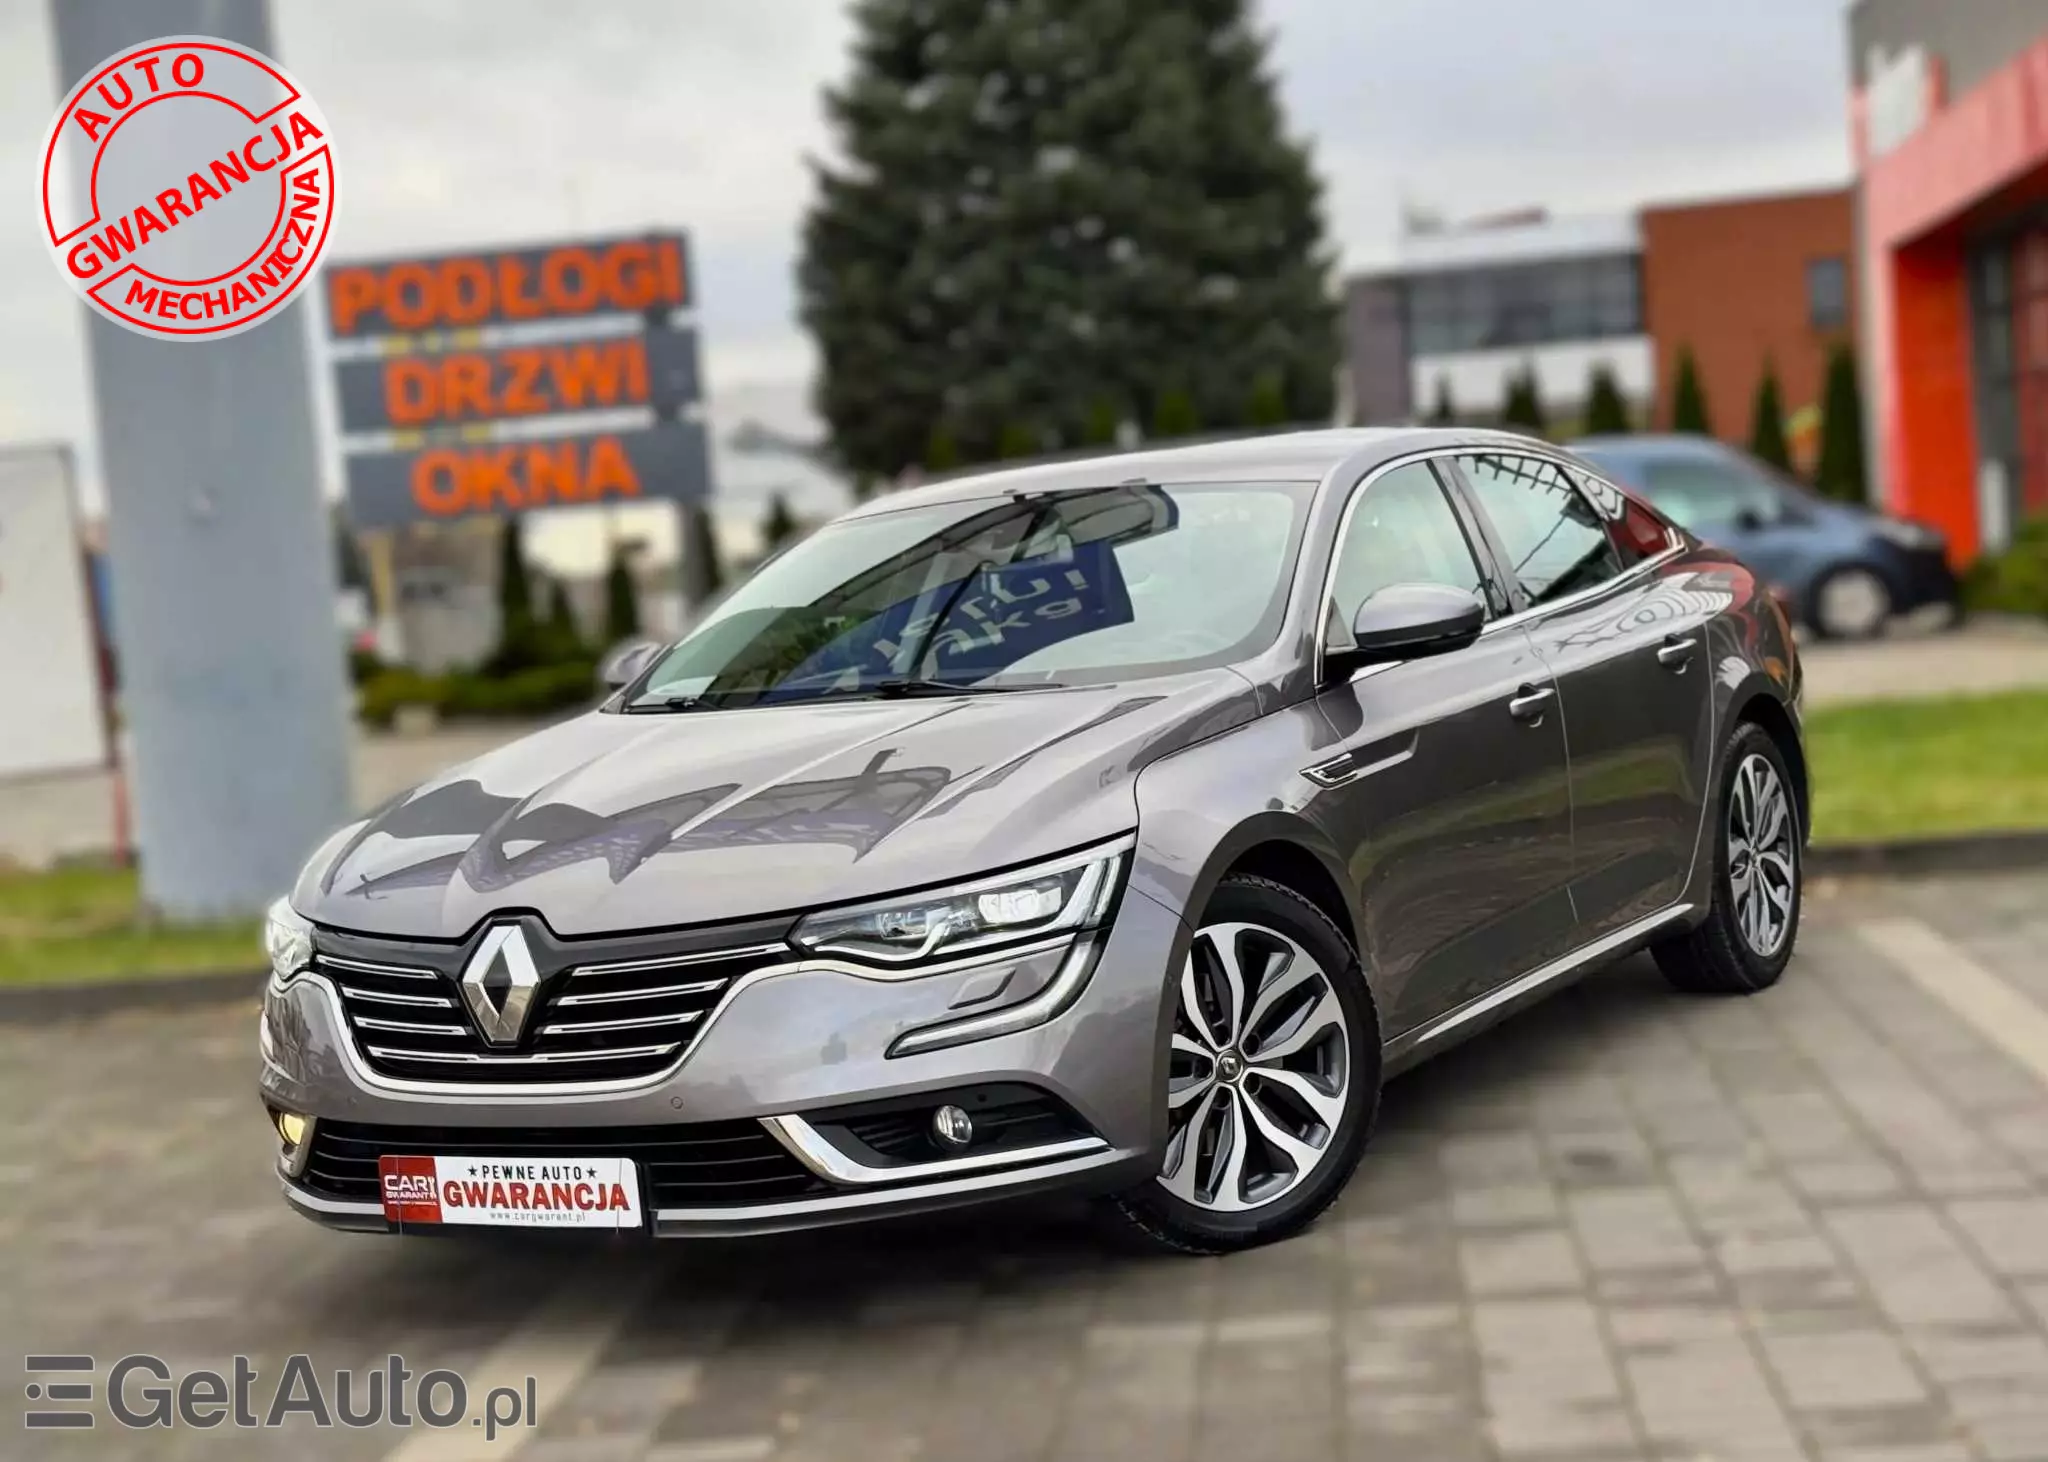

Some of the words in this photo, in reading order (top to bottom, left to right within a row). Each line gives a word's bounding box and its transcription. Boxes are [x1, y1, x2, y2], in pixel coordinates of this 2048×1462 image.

[330, 240, 683, 333] PODŁOGI
[385, 338, 649, 424] DRZWI
[412, 435, 639, 515] OKNA
[443, 1181, 631, 1211] GWARANCJA
[482, 1165, 535, 1180] PEWNE
[542, 1166, 582, 1180] AUTO
